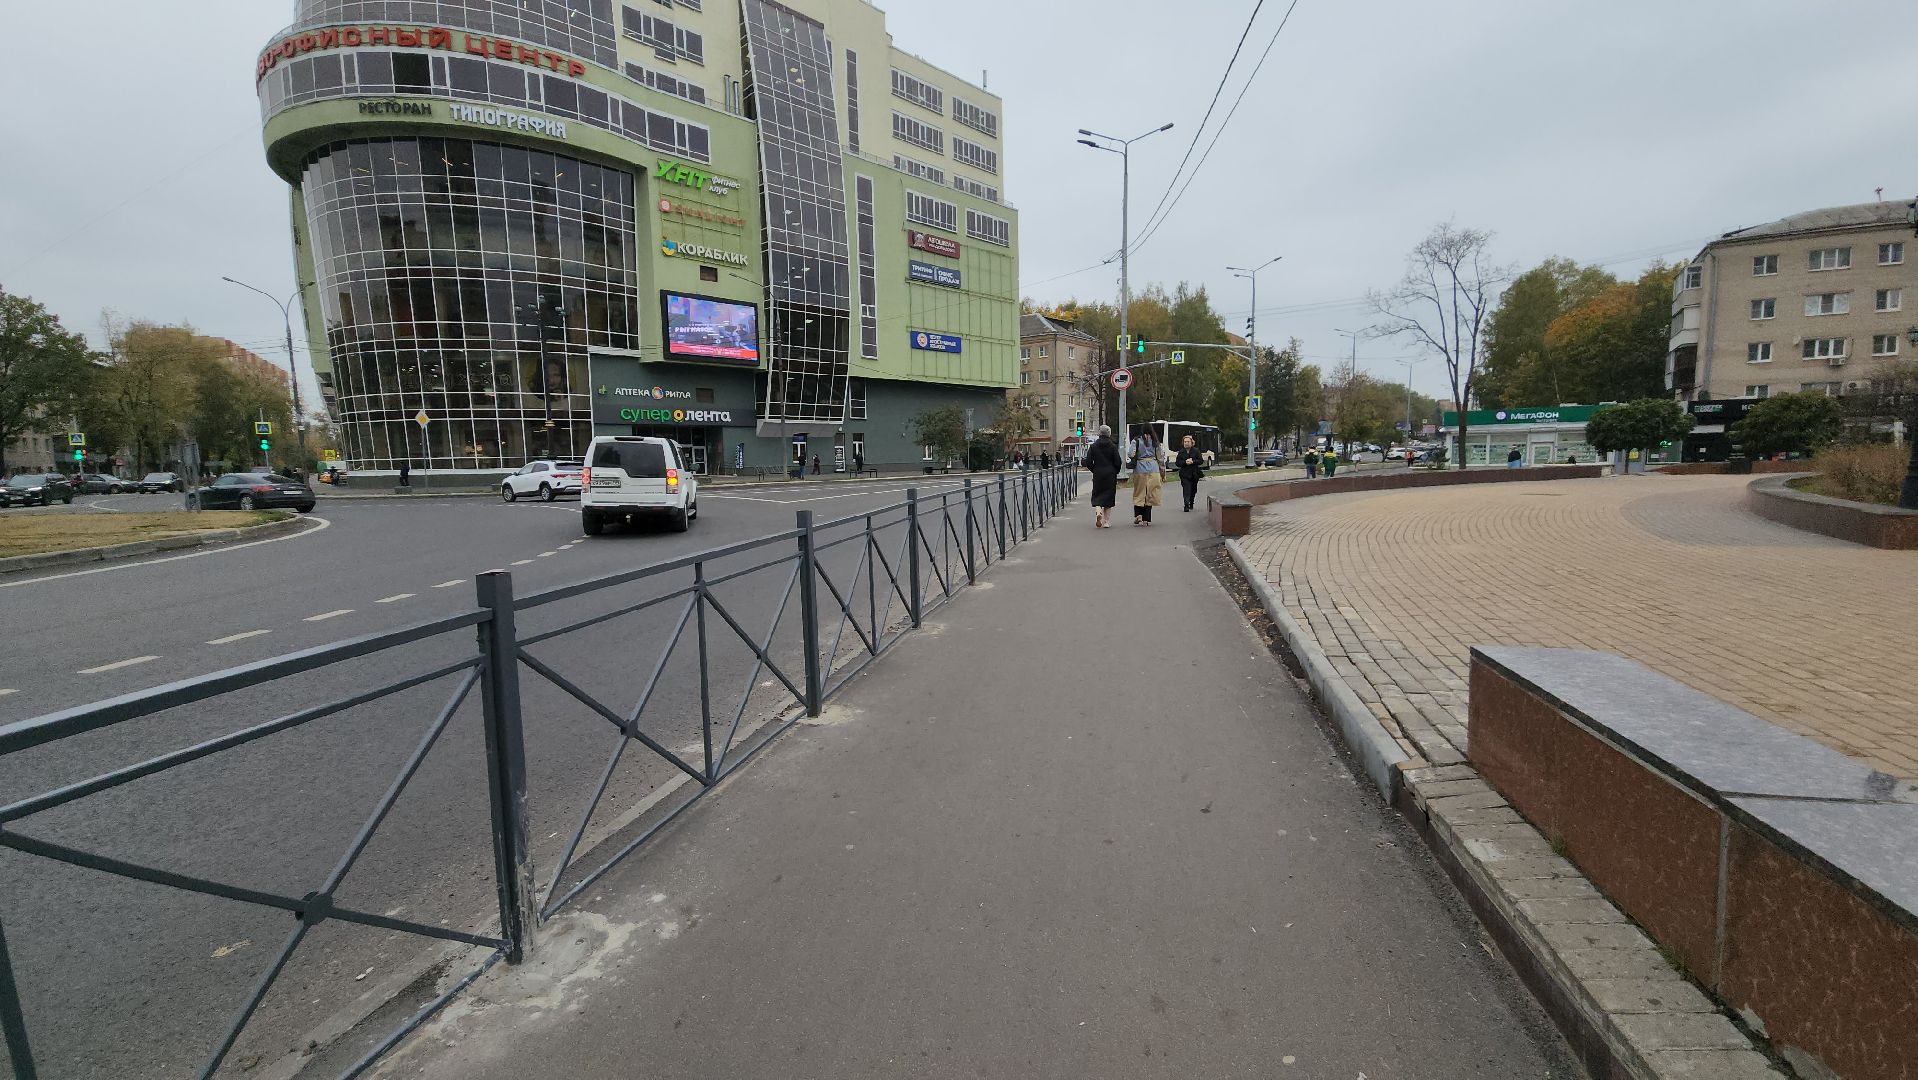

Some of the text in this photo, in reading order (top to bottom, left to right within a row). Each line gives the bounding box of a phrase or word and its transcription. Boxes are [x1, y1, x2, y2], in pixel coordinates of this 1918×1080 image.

[464, 33, 586, 77] ЦЕНТР
[358, 101, 432, 116] РЕСТОРАН
[450, 103, 567, 139] ТИПОГРАФИЯ
[653, 158, 707, 188] XFIT
[708, 185, 729, 195] клуб
[711, 176, 740, 189] фитнес
[677, 242, 748, 266] КОРАБЛИК
[614, 387, 691, 399] АПТЕКА РИГЛА
[620, 408, 732, 423] супер лента
